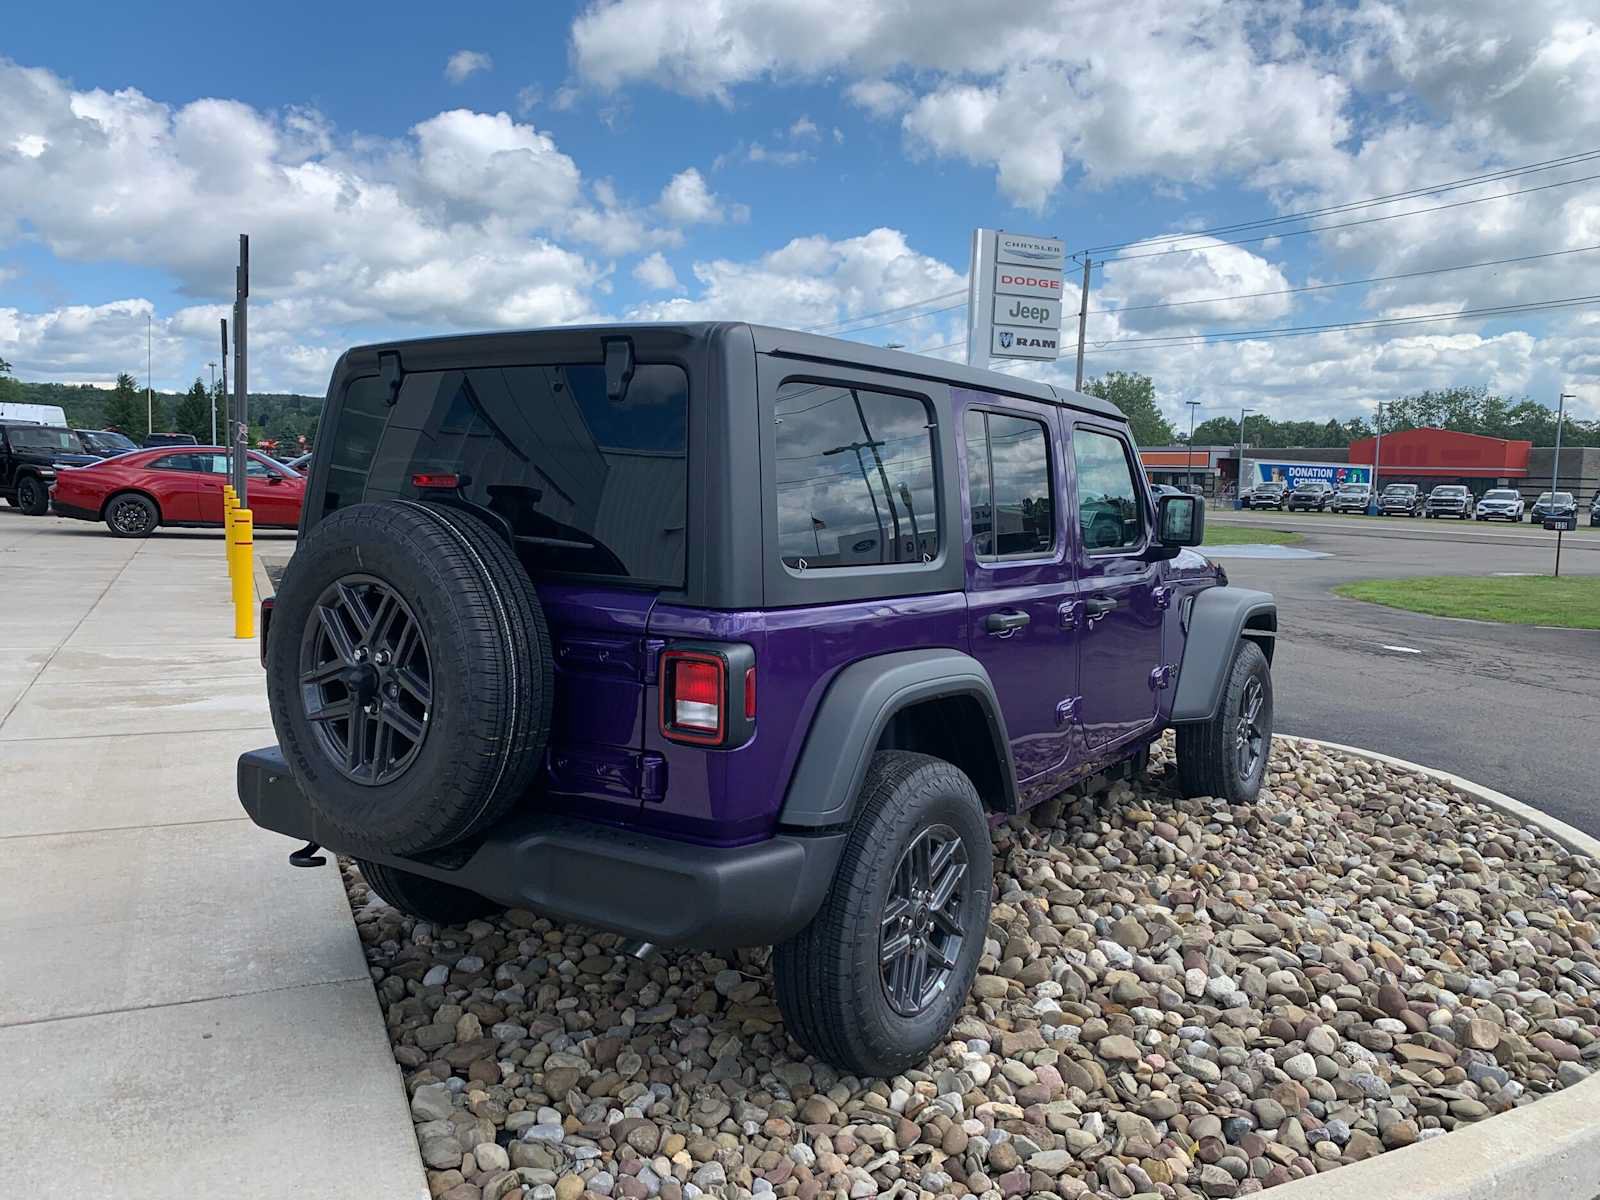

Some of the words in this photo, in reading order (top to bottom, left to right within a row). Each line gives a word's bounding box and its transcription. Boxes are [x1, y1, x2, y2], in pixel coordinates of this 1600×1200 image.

[1004, 241, 1060, 253] CHRYSLER
[1001, 275, 1060, 289] DODGE
[1009, 301, 1050, 324] Jeep
[1016, 337, 1056, 349] RAM
[1289, 467, 1333, 478] DONATION
